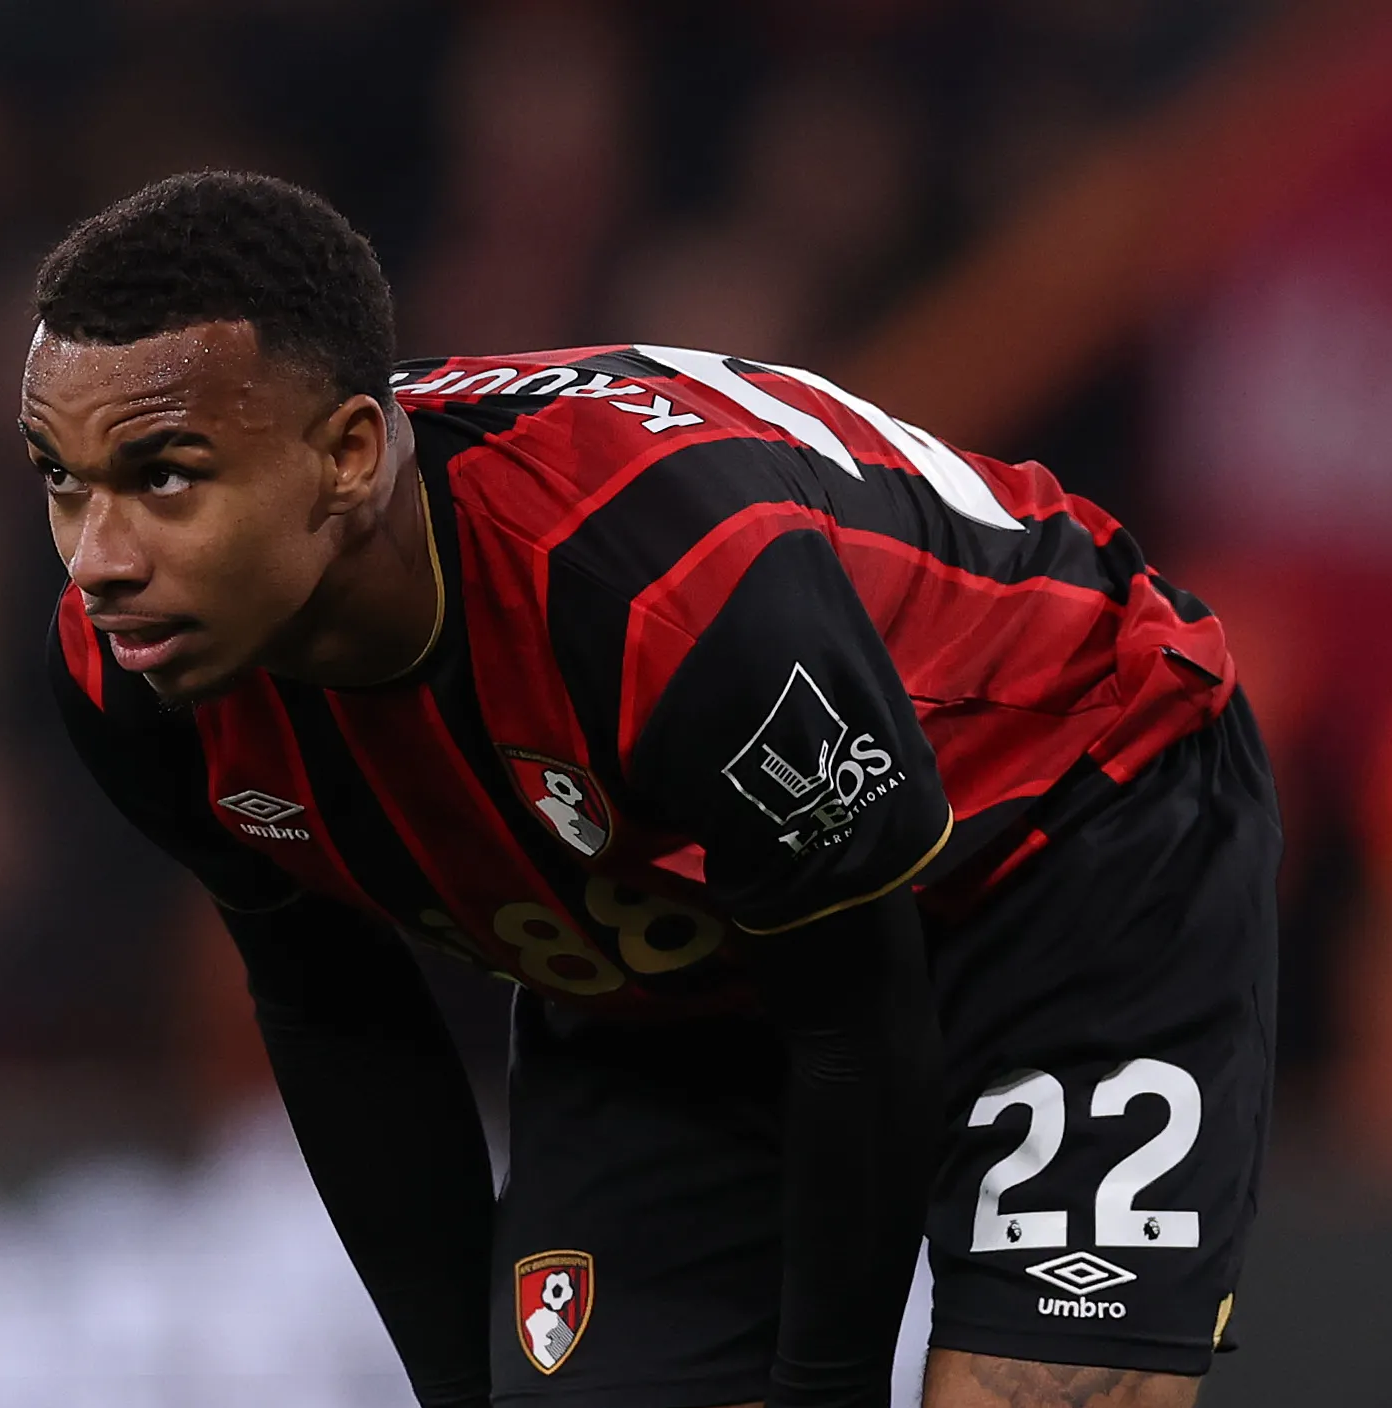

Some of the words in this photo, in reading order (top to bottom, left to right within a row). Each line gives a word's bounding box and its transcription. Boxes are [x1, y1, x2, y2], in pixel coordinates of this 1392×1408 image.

[240, 823, 310, 841] umbro
[967, 1058, 1202, 1253] 22
[1038, 1296, 1127, 1319] umbro
